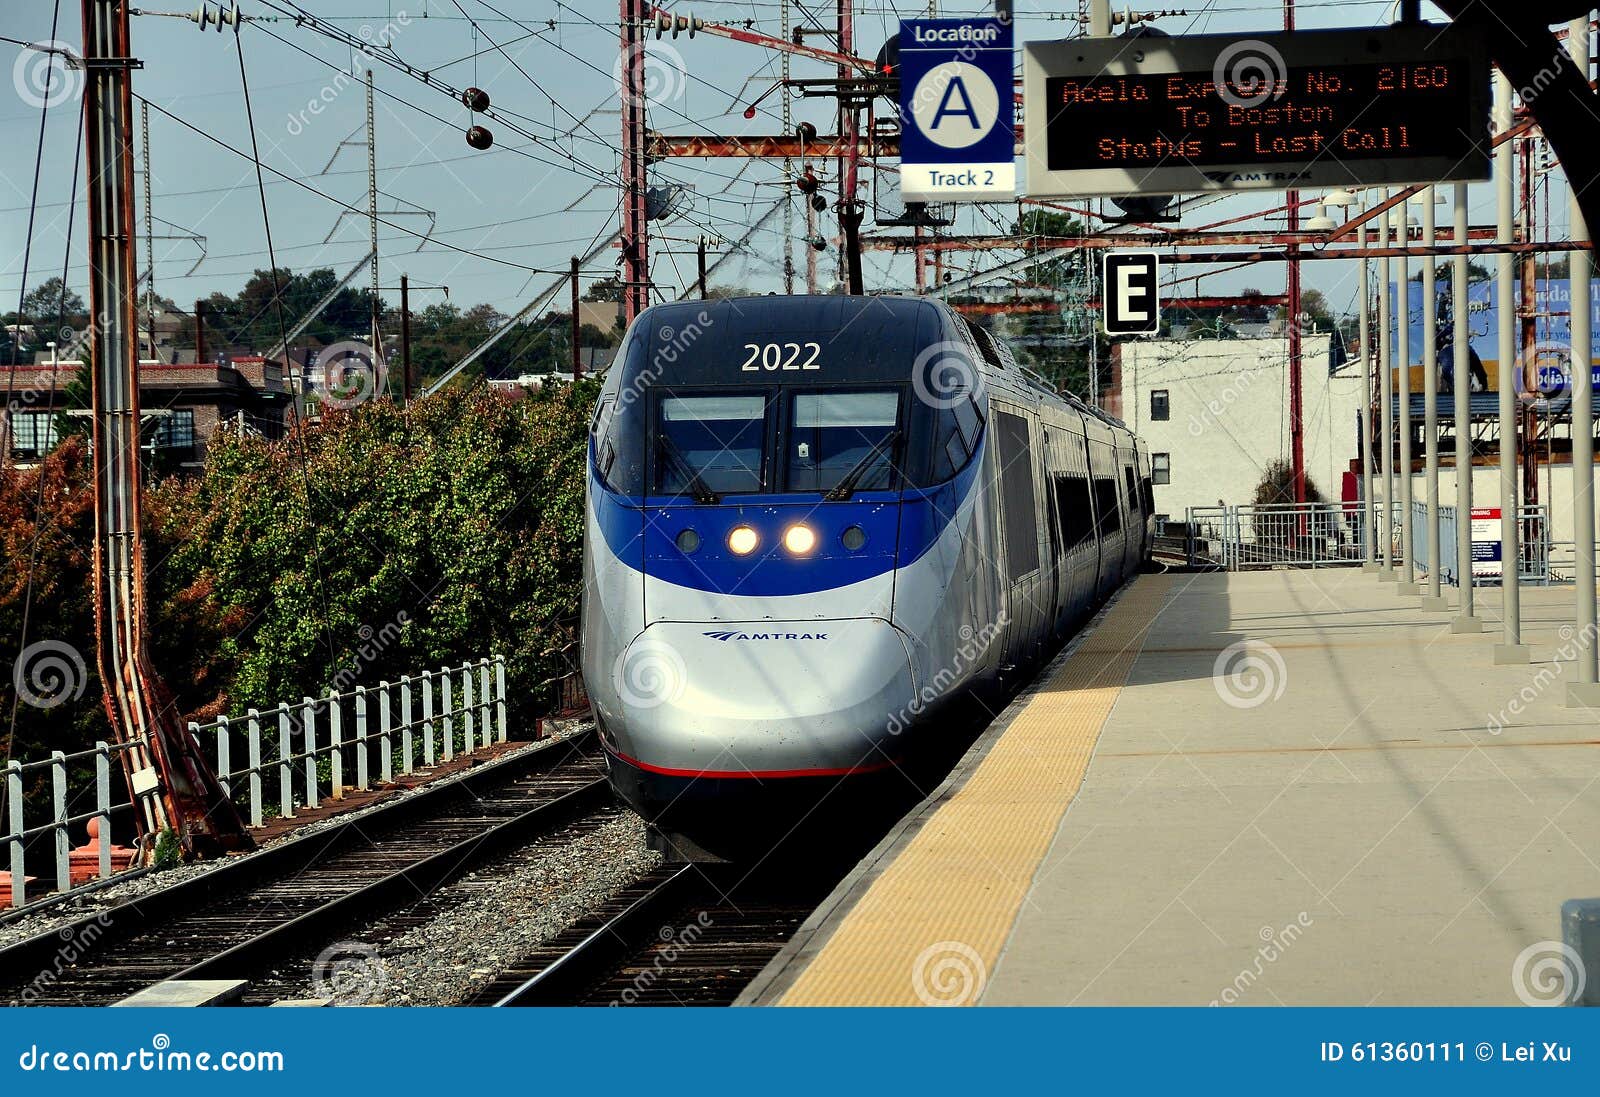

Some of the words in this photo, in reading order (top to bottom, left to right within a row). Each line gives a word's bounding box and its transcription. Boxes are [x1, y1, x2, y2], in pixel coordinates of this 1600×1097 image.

[915, 26, 996, 42] Location
[1063, 81, 1149, 102] Acela
[1167, 78, 1288, 99] Express
[1307, 72, 1353, 93] No.
[1377, 66, 1448, 90] 2160
[930, 76, 981, 129] A
[1176, 106, 1210, 128] To
[1228, 102, 1333, 125] Boston
[1098, 137, 1202, 159] Status
[1254, 130, 1324, 153] Last
[1343, 125, 1410, 149] Call
[929, 170, 976, 186] Track
[984, 170, 994, 186] 2
[1232, 171, 1312, 182] AMTRAK
[1117, 265, 1148, 322] E
[742, 343, 821, 371] 2022
